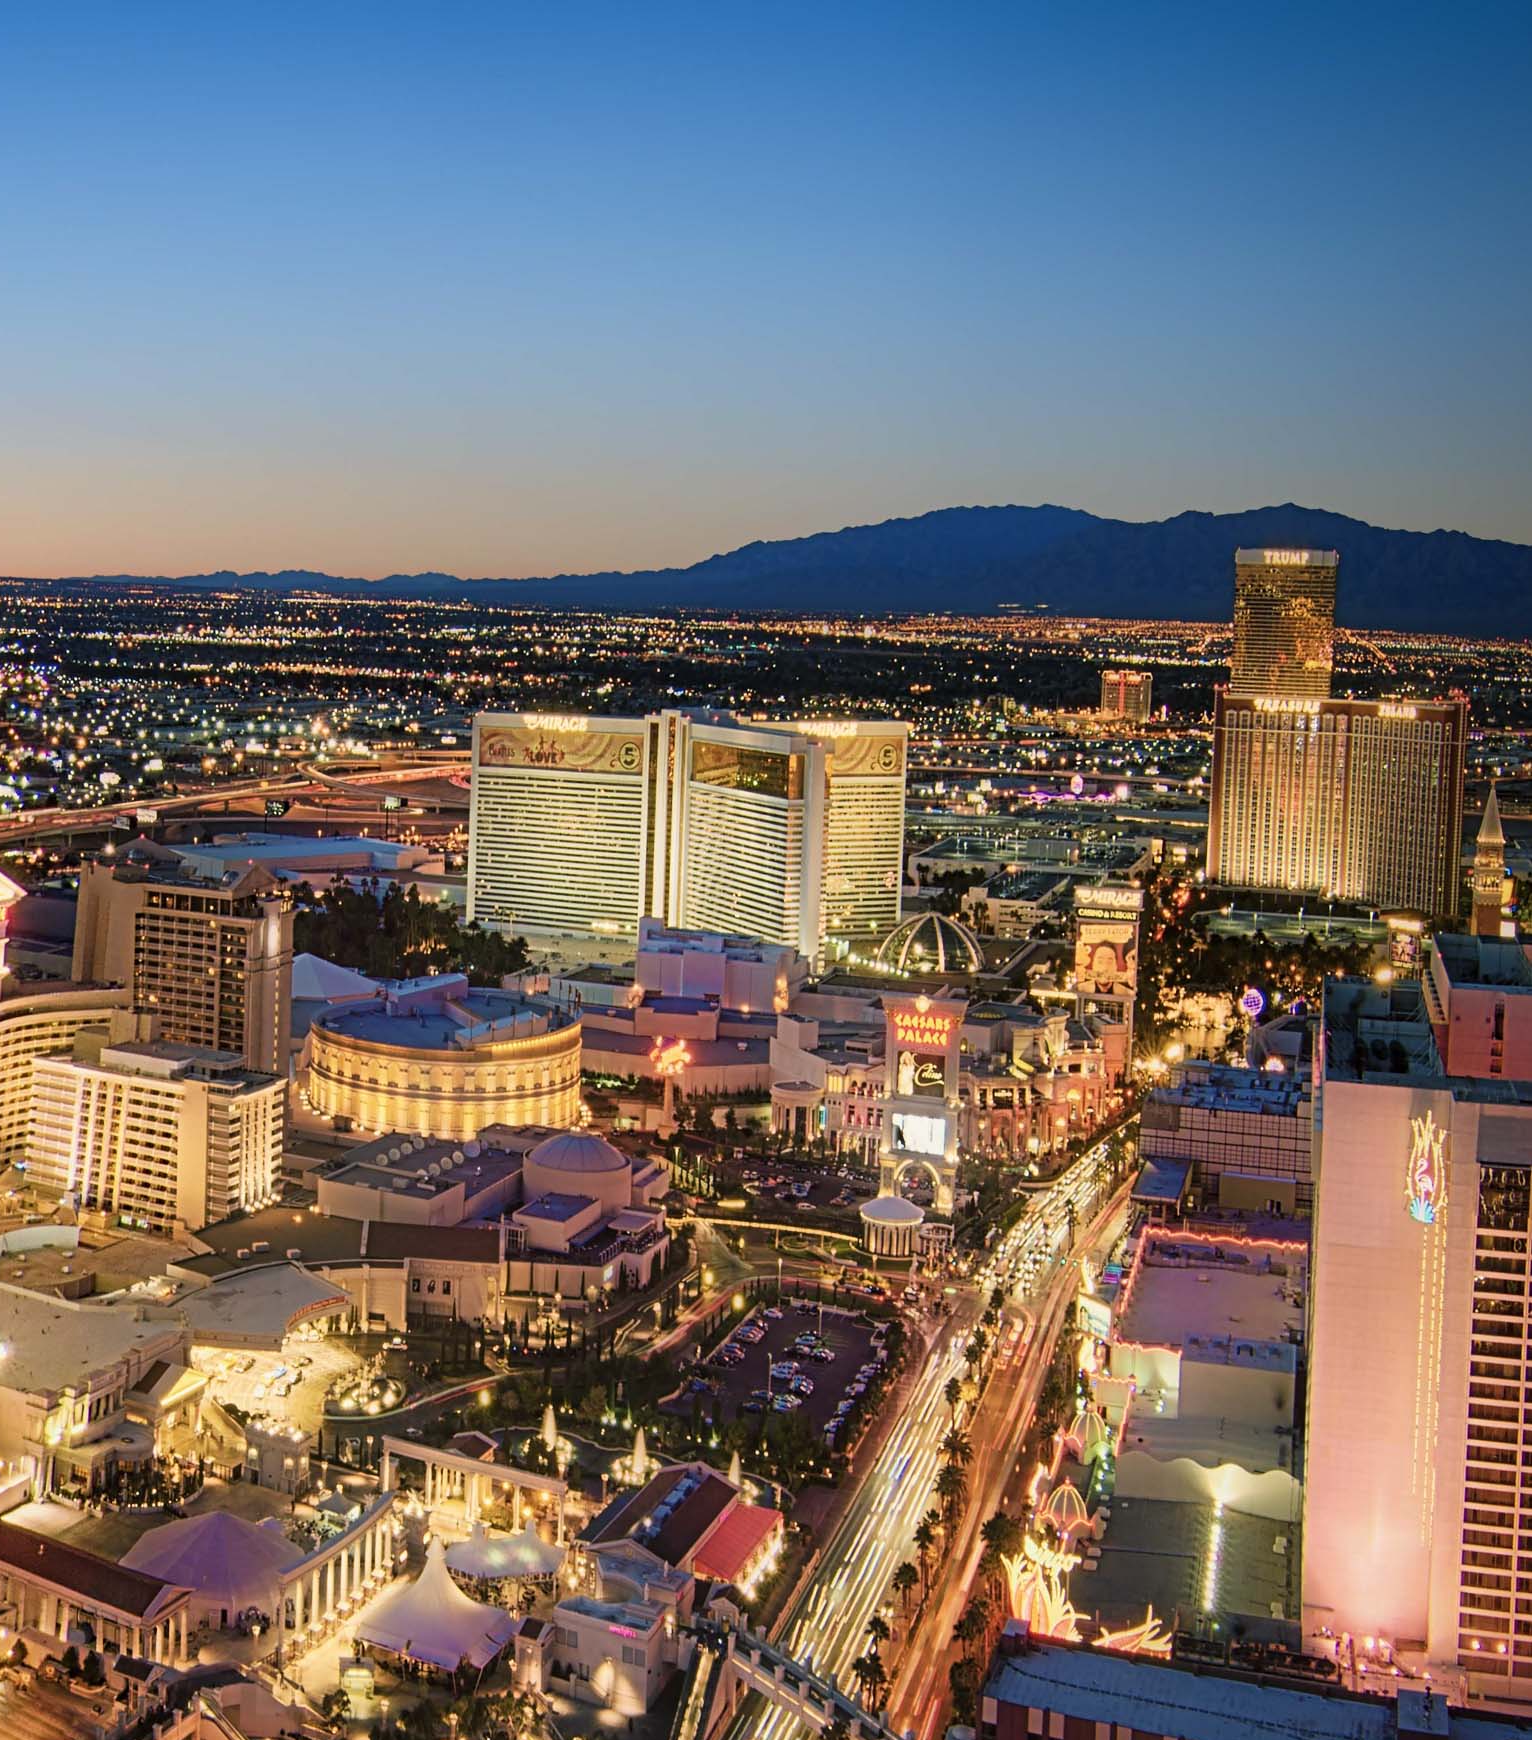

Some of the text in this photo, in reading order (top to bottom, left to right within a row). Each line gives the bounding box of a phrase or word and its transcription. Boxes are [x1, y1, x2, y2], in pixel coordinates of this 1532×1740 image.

[1264, 551, 1309, 565] TRUMP
[1254, 698, 1321, 715] TREASURE
[535, 715, 588, 732] MIRAGE
[530, 751, 557, 764] LOVE
[1094, 889, 1142, 907] MIRAGE
[1078, 908, 1103, 918] CASINO
[1110, 911, 1137, 920] RESORT
[895, 1013, 951, 1031] CAESARS
[897, 1028, 948, 1046] PALACE
